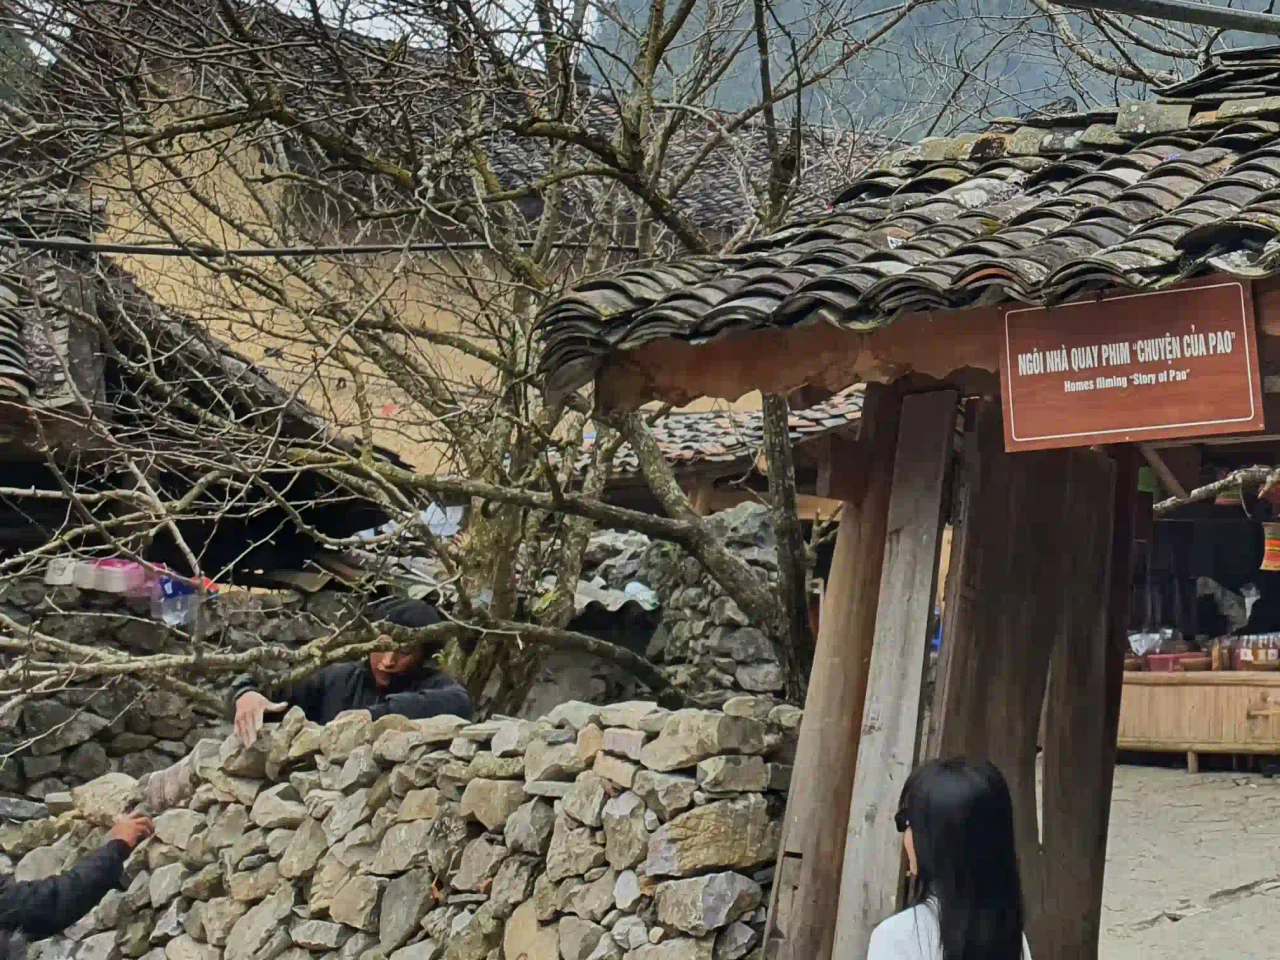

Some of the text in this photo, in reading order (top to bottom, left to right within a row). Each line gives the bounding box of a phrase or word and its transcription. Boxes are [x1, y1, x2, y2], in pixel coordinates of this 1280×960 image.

[1046, 344, 1069, 373] NHÀ
[1071, 345, 1098, 372] QUAY
[1101, 342, 1131, 367] PHIM
[1183, 324, 1207, 358] CỦA
[1064, 380, 1094, 393] Homes
[1096, 375, 1128, 389] filming
[1158, 370, 1168, 382] of
